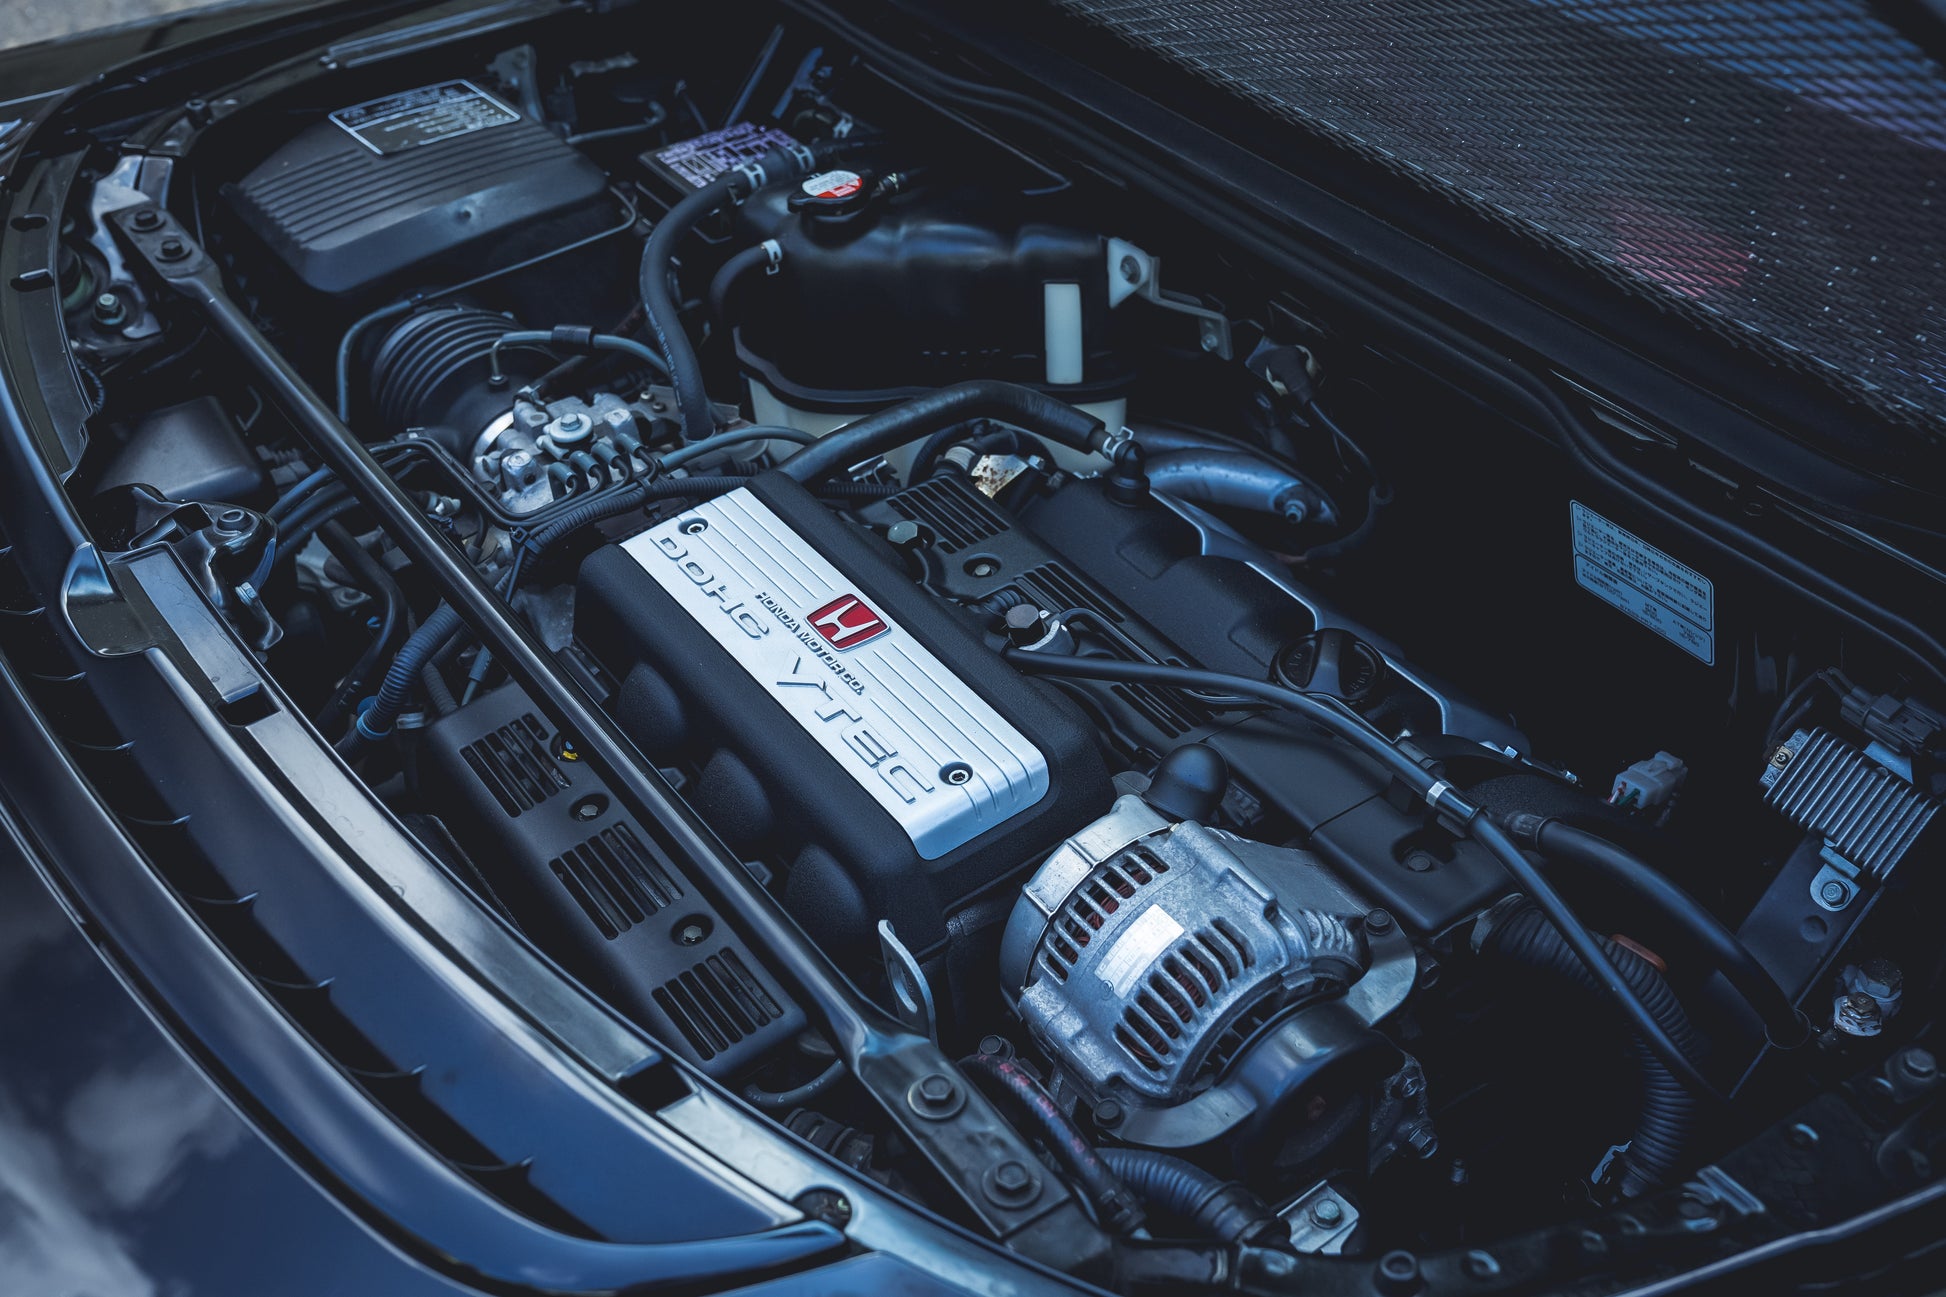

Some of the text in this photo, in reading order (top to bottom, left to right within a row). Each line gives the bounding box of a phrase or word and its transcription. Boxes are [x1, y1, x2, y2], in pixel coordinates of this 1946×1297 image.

[648, 530, 770, 640] DOHC
[755, 591, 866, 696] HONDA MOTOR CO.
[775, 648, 936, 805] VTEC
